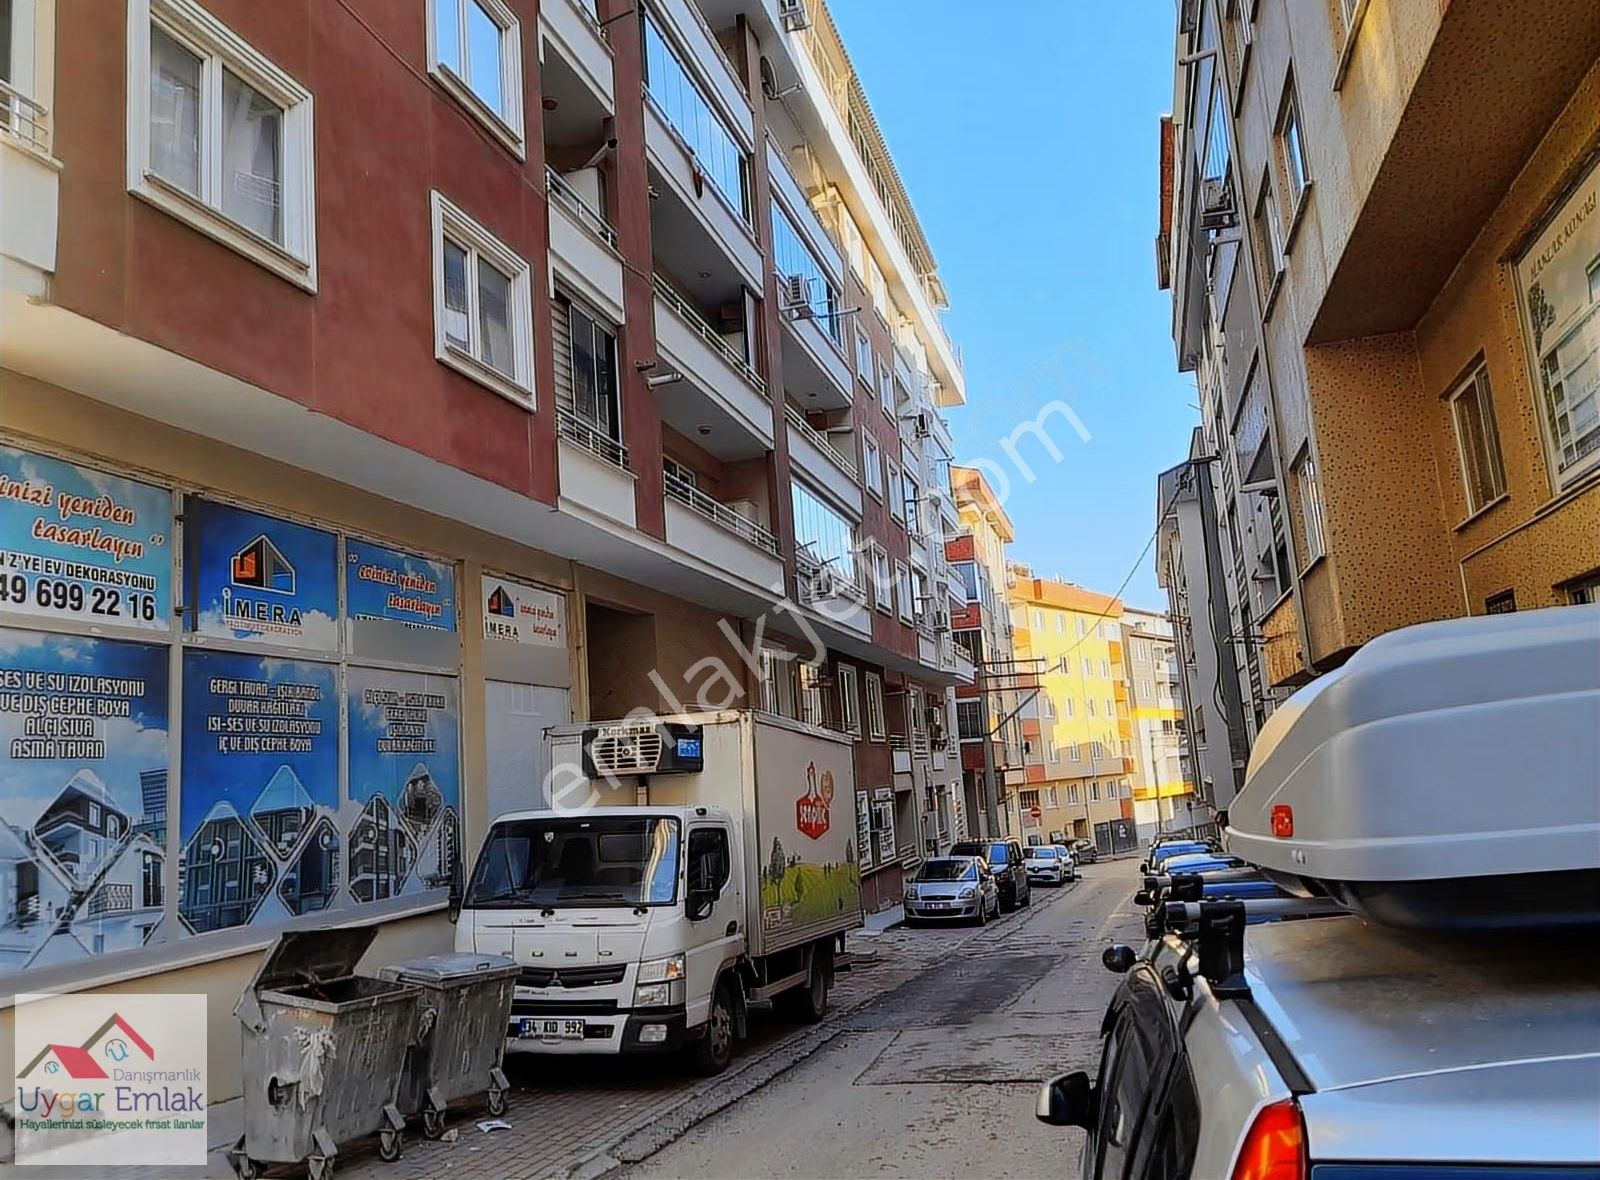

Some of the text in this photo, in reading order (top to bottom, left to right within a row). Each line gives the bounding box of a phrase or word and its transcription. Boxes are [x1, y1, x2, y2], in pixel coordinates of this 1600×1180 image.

[57, 492, 136, 525] yeniden
[32, 518, 144, 564] tasarlayın
[44, 558, 62, 576] EV
[65, 562, 156, 591] DEKORASYONU
[36, 577, 84, 612] 699
[91, 586, 121, 617] 22
[128, 593, 156, 622] 16
[47, 673, 65, 691] SU
[23, 694, 48, 716] DIŞ
[51, 696, 95, 715] CEPHE
[97, 699, 130, 717] BOYA
[26, 717, 94, 740] ALÇI SIVA
[12, 740, 104, 758] ASMA TAVAN
